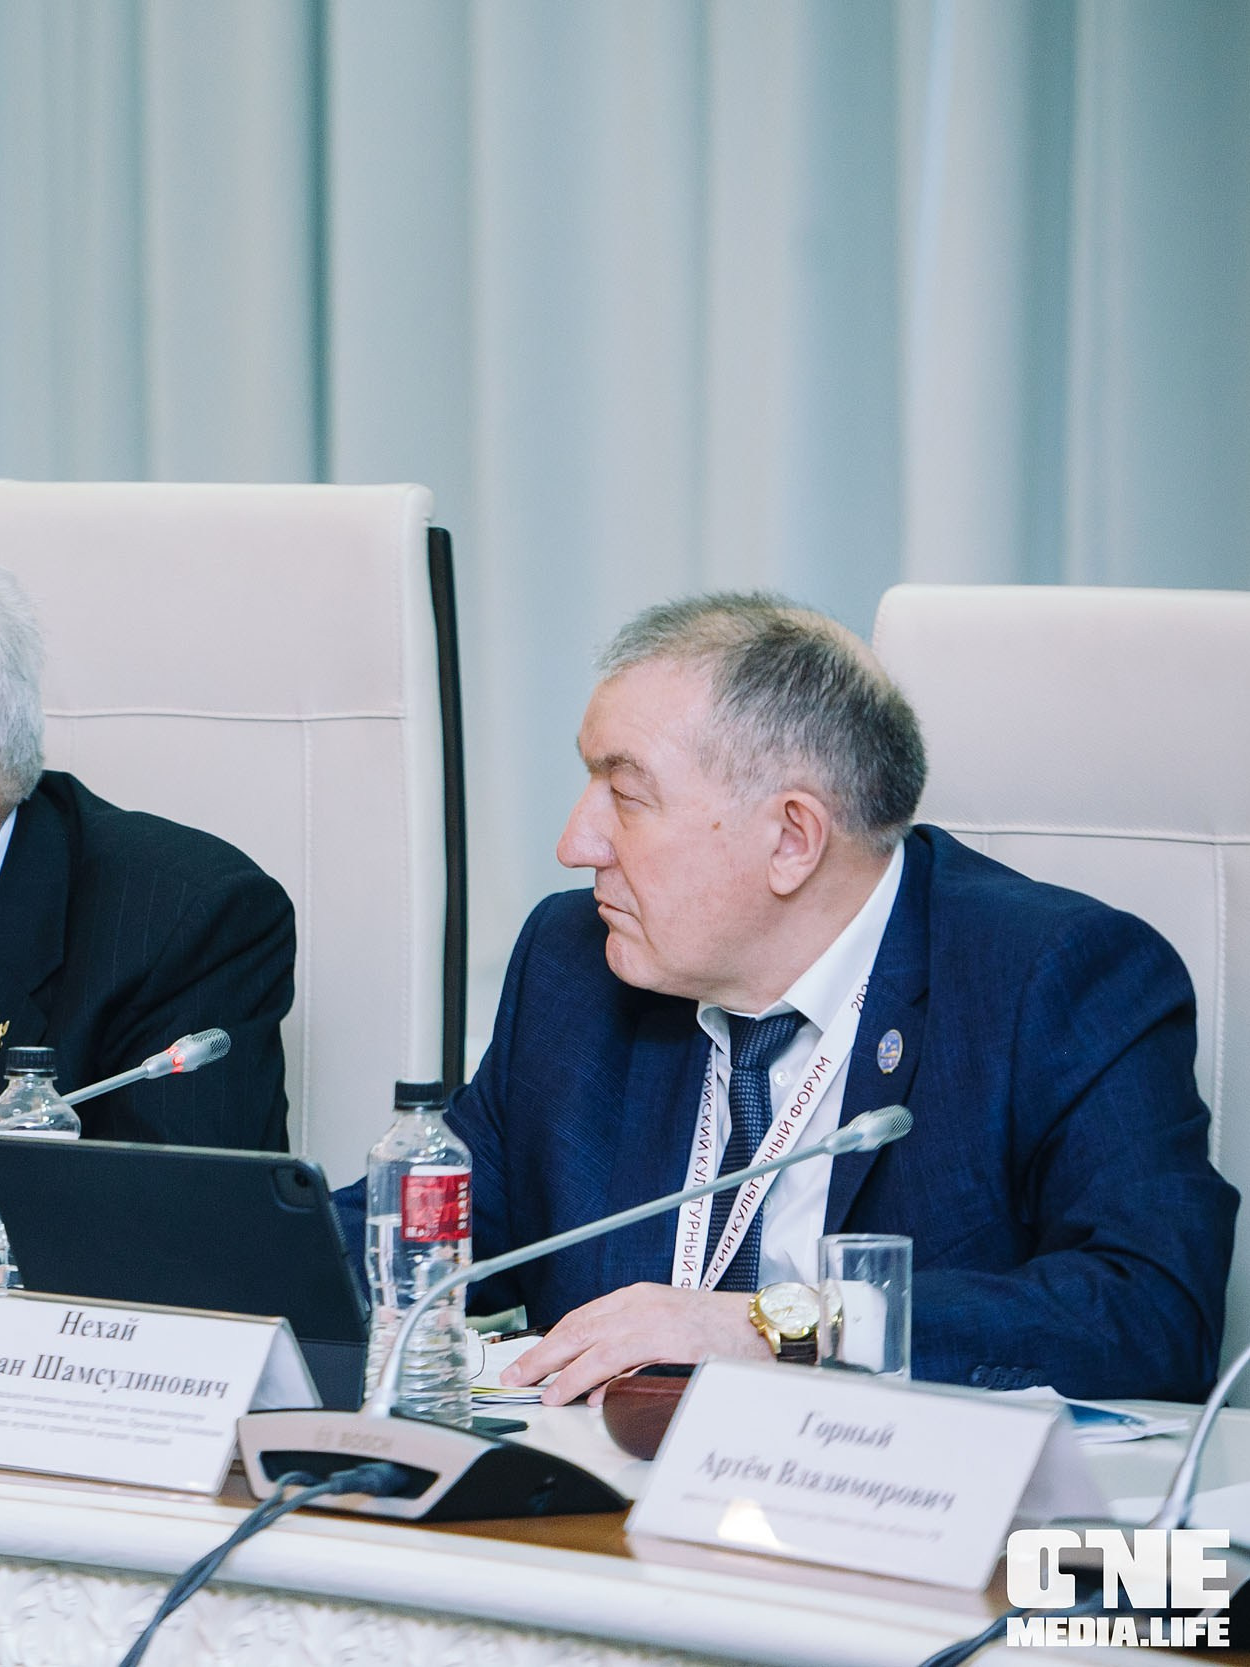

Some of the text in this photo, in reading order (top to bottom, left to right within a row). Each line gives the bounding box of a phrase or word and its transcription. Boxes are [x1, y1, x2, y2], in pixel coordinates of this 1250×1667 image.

[790, 1055, 833, 1119] ФОРУМ
[681, 1155, 709, 1274] КУЛТУРНЫЙ
[59, 1309, 140, 1342] Нехай
[31, 1353, 230, 1400] Шамсудинович
[797, 1410, 897, 1450] Горный
[698, 1449, 957, 1513] Артём Владимирович
